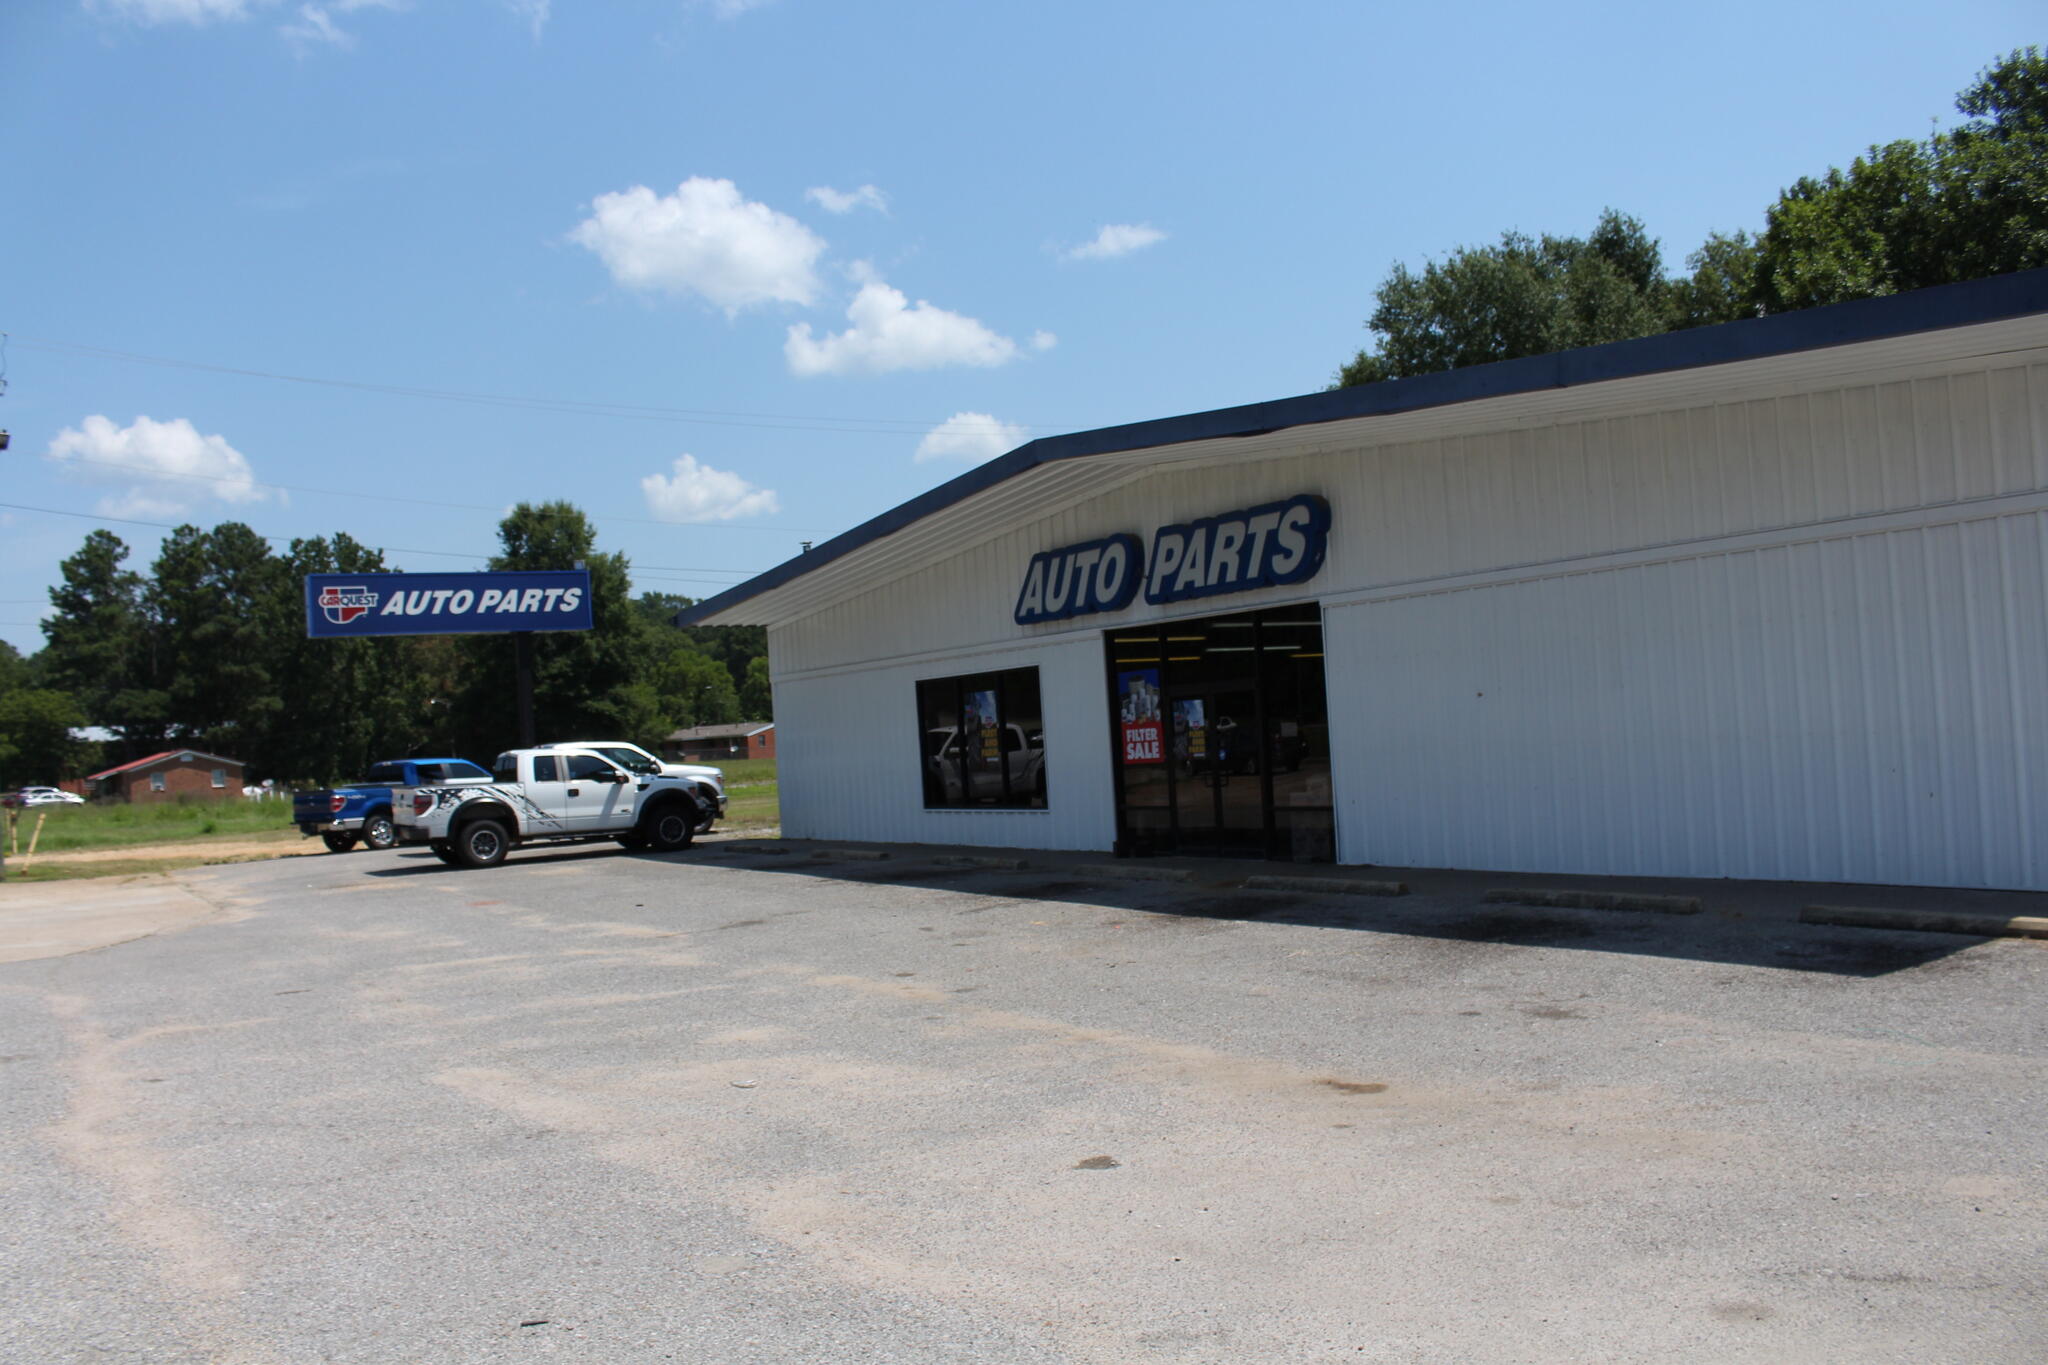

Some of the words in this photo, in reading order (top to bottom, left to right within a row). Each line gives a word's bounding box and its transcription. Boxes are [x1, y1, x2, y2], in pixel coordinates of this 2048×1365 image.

[1018, 542, 1127, 617] AUTO
[1149, 504, 1311, 596] PARTS
[320, 593, 377, 608] CARQUEST
[380, 589, 474, 616] AUTO
[477, 587, 583, 614] PARTS
[1126, 728, 1158, 742] FILTER
[1126, 741, 1160, 760] SALE
